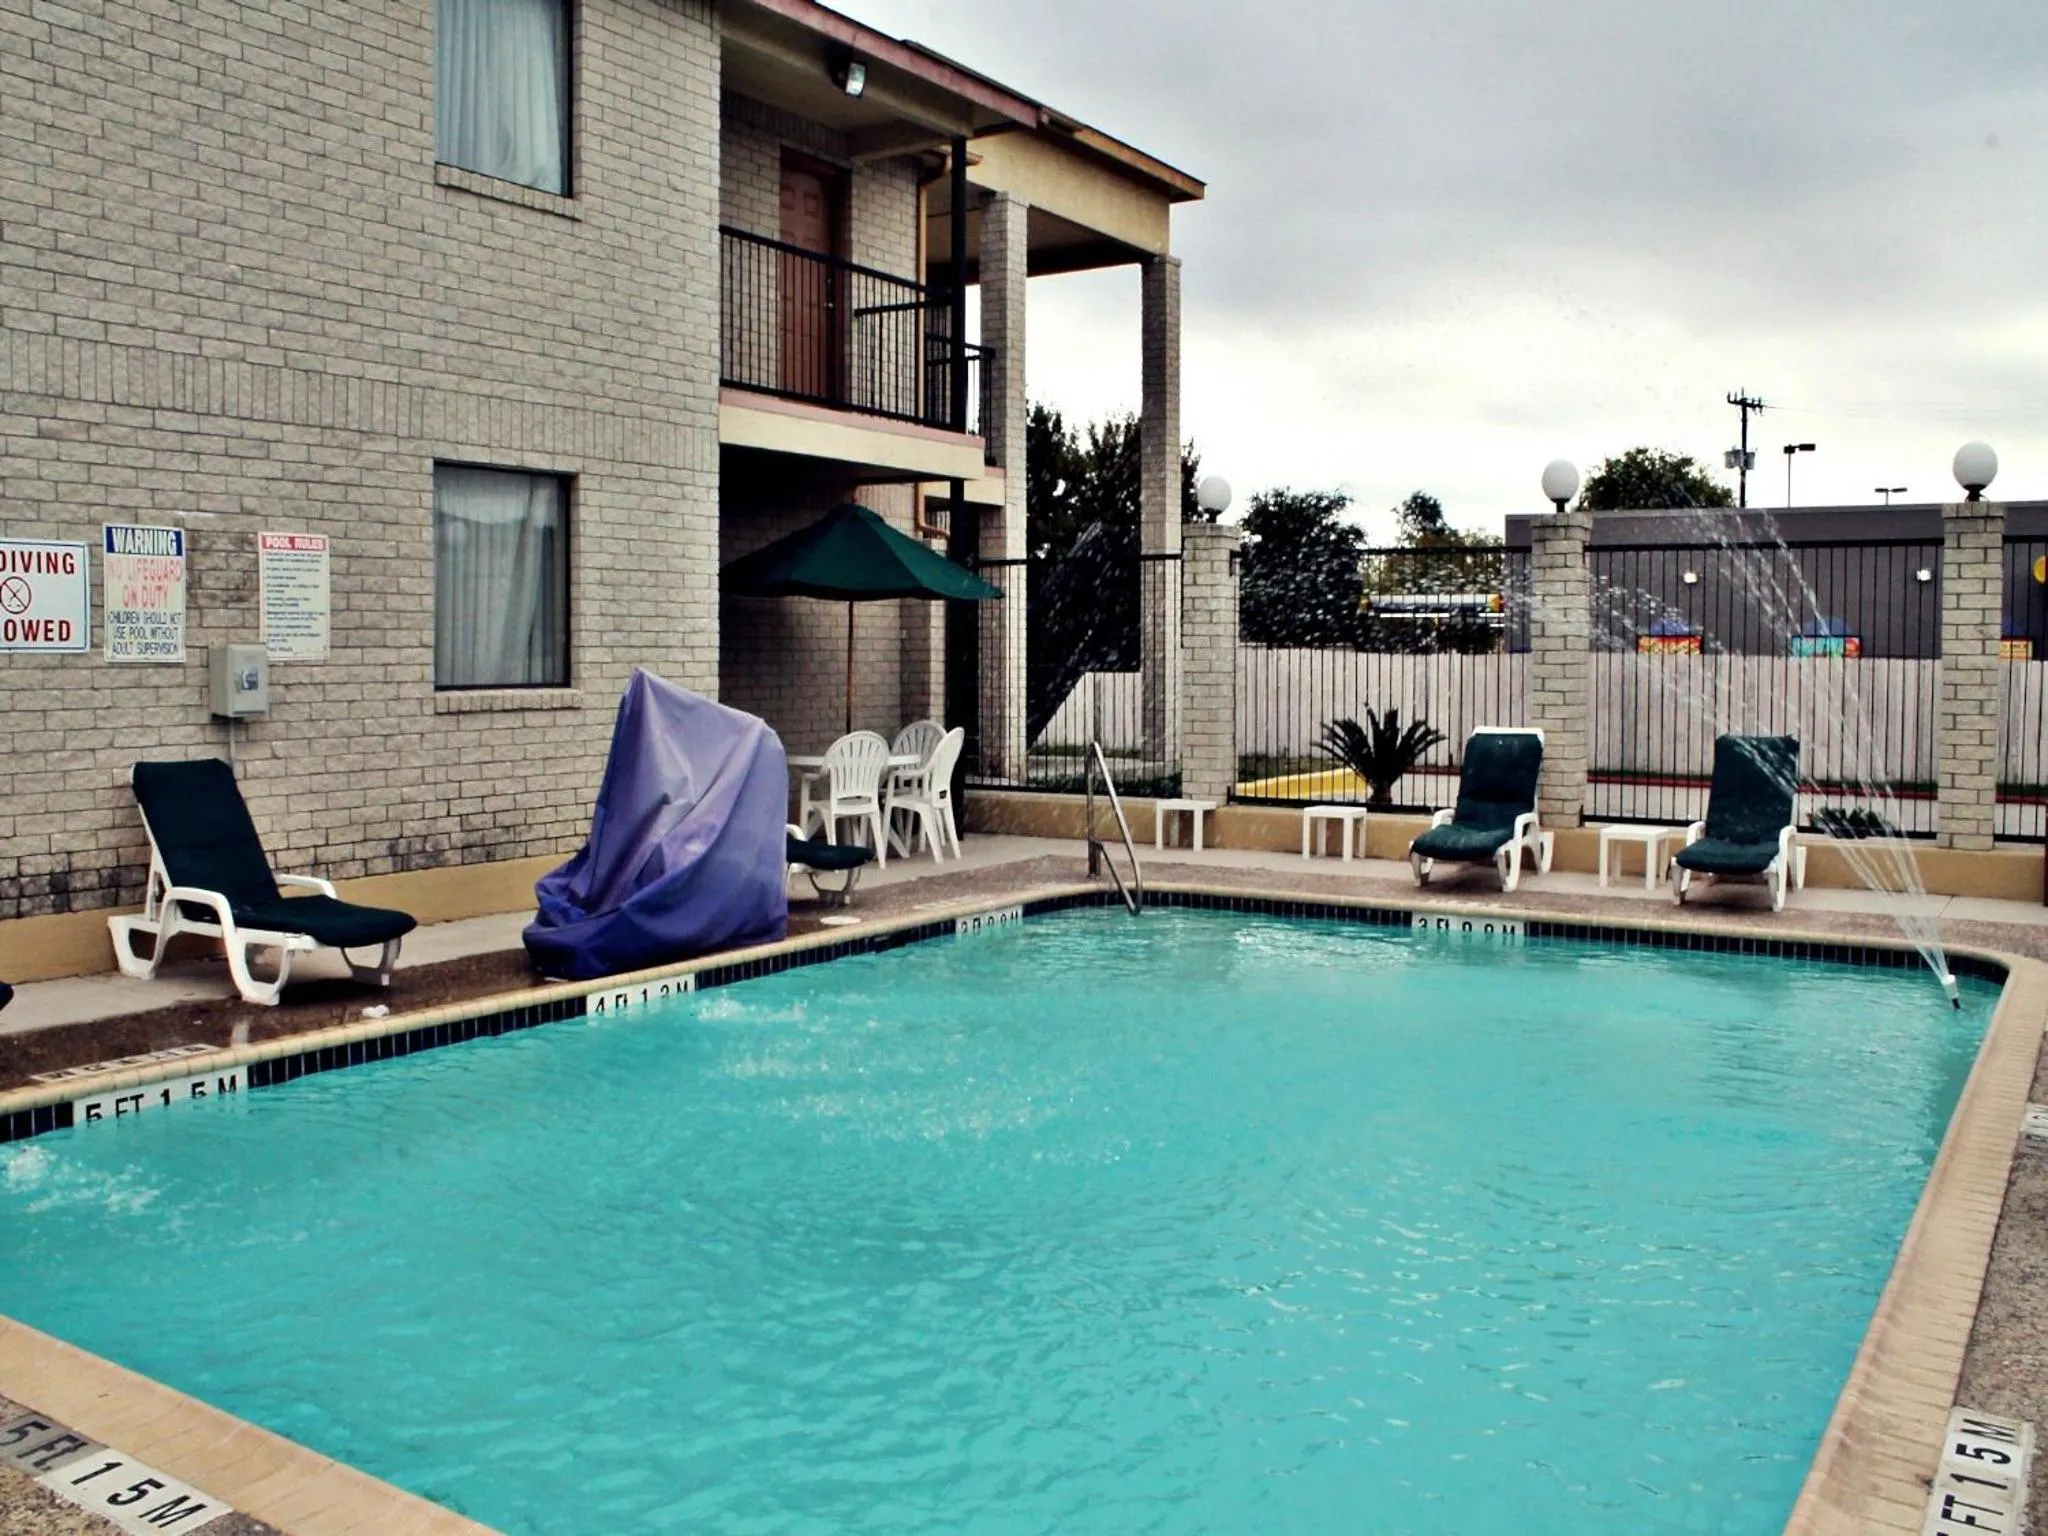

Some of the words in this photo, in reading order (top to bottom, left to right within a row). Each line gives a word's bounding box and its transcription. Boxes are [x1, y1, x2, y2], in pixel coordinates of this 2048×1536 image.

[112, 528, 177, 555] WARNING
[265, 536, 290, 549] POOL
[122, 584, 138, 609] ON
[141, 585, 168, 609] DUTY
[129, 626, 148, 640] POOL
